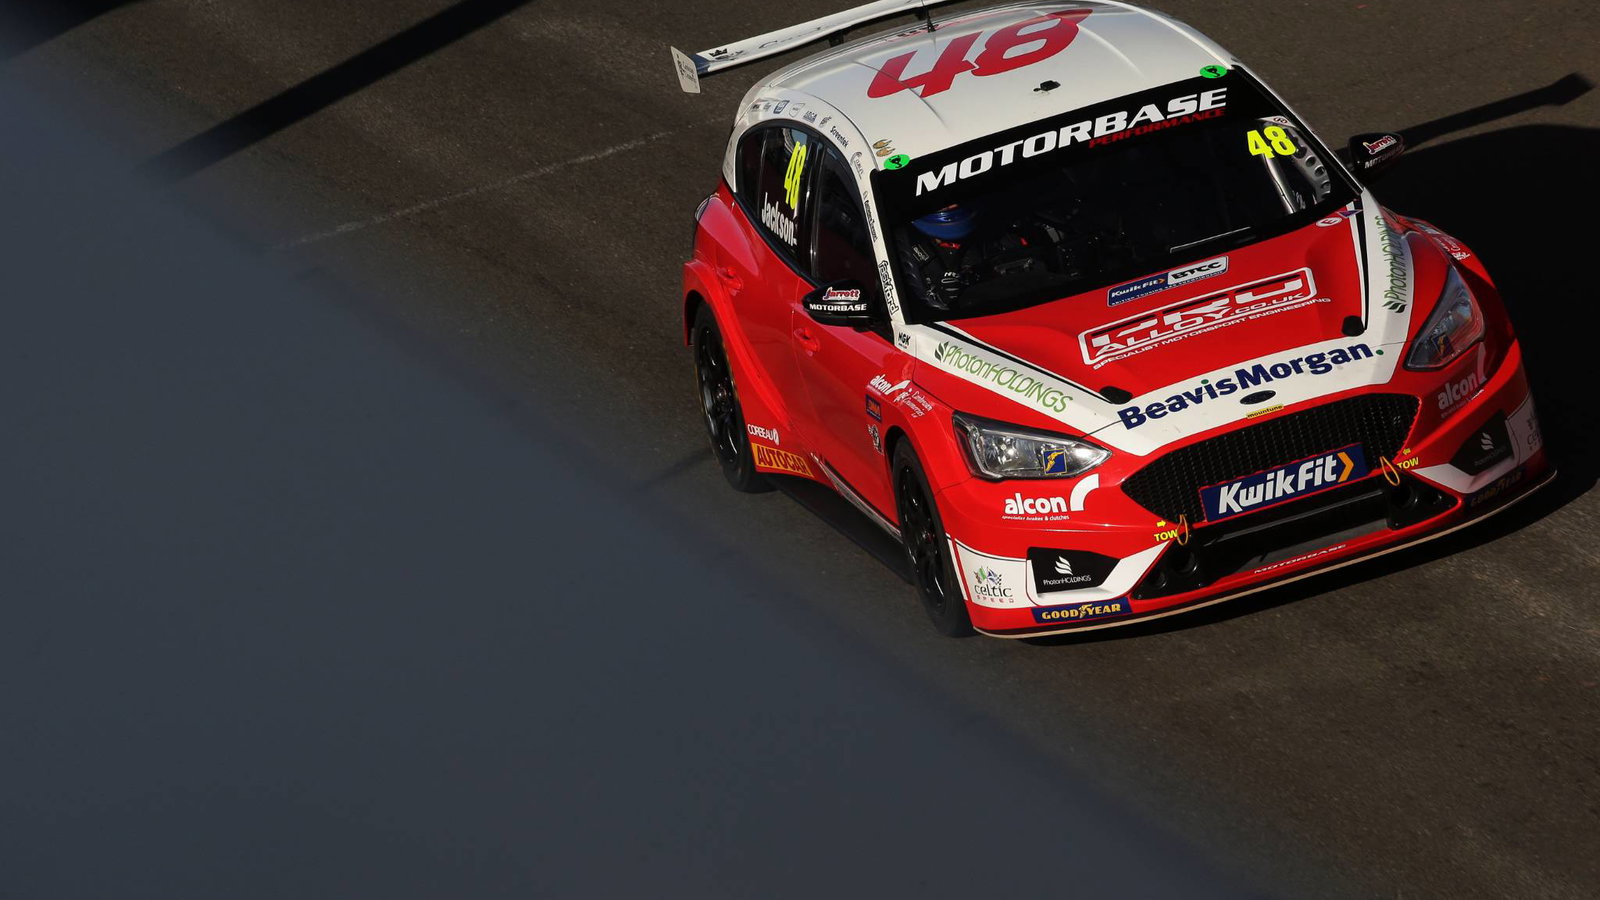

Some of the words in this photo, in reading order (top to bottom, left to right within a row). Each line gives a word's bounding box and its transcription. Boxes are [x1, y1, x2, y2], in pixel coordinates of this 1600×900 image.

[867, 8, 1093, 99] 48
[915, 87, 1227, 197] MOTORBASE
[1088, 107, 1225, 149] PERFORMANCE
[1246, 125, 1296, 159] 48
[784, 141, 807, 210] 48
[761, 191, 795, 247] Jackson
[1171, 261, 1223, 280] BTCC
[809, 303, 867, 312] MOTORBASE
[1093, 344, 1160, 370] SPECIALIST
[1161, 317, 1247, 346] MOTORSPORT
[1248, 297, 1332, 320] ENGINEERING
[870, 374, 892, 395] alcon
[943, 345, 1074, 413] PhotonHOLDINGS
[1438, 371, 1478, 410] alcon
[757, 444, 811, 475] AUTOCAR
[1397, 457, 1419, 471] TOW
[1218, 469, 1296, 514] Kwik
[1297, 452, 1337, 491] Fit
[1004, 493, 1067, 515] alcon
[1154, 528, 1178, 542] TOW
[974, 583, 1013, 598] celtic
[1043, 574, 1092, 586] PhotonHOLDINGS
[1041, 603, 1121, 620] GOODYEAR
